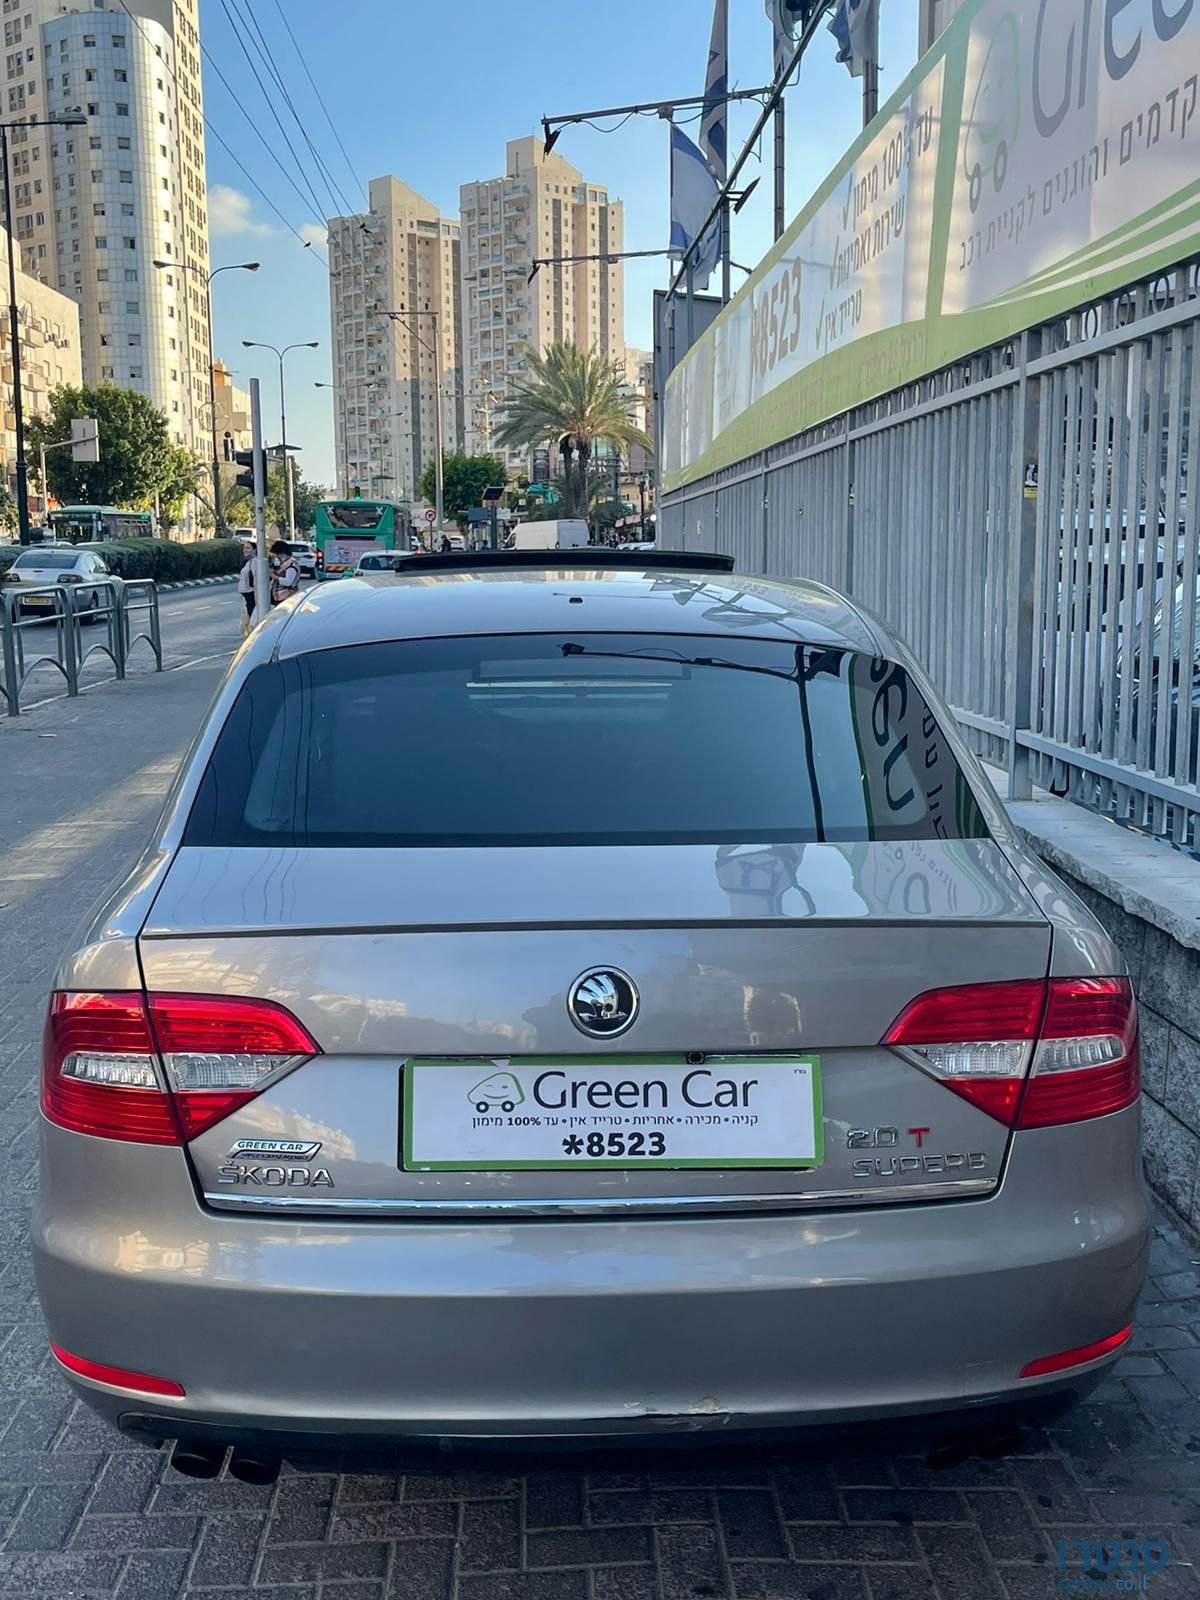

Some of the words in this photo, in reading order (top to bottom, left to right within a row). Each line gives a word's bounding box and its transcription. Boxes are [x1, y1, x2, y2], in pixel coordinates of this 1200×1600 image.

[916, 105, 934, 158] עד
[1042, 137, 1109, 216] והוגנים
[852, 164, 879, 233] מימון
[872, 194, 906, 258] שירות
[986, 185, 1036, 254] לקניית
[836, 226, 871, 289] ואמינות
[959, 231, 982, 272] רכב
[839, 287, 862, 336] טרייד
[824, 306, 838, 355] אין
[533, 1070, 669, 1110] Green
[681, 1069, 759, 1109] Car
[472, 1116, 503, 1129] מימון
[507, 1116, 541, 1127] 100%
[544, 1116, 559, 1127] עד
[570, 1115, 587, 1128] אין
[590, 1115, 622, 1127] טרייד
[631, 1115, 674, 1126] אחריות
[685, 1115, 721, 1126] מכירה
[731, 1114, 759, 1127] קניה
[237, 1140, 277, 1150] GREEN
[280, 1142, 304, 1151] CAR
[907, 1126, 931, 1149] T
[217, 1159, 336, 1188] ŠKODA
[852, 1151, 987, 1178] SUPERB
